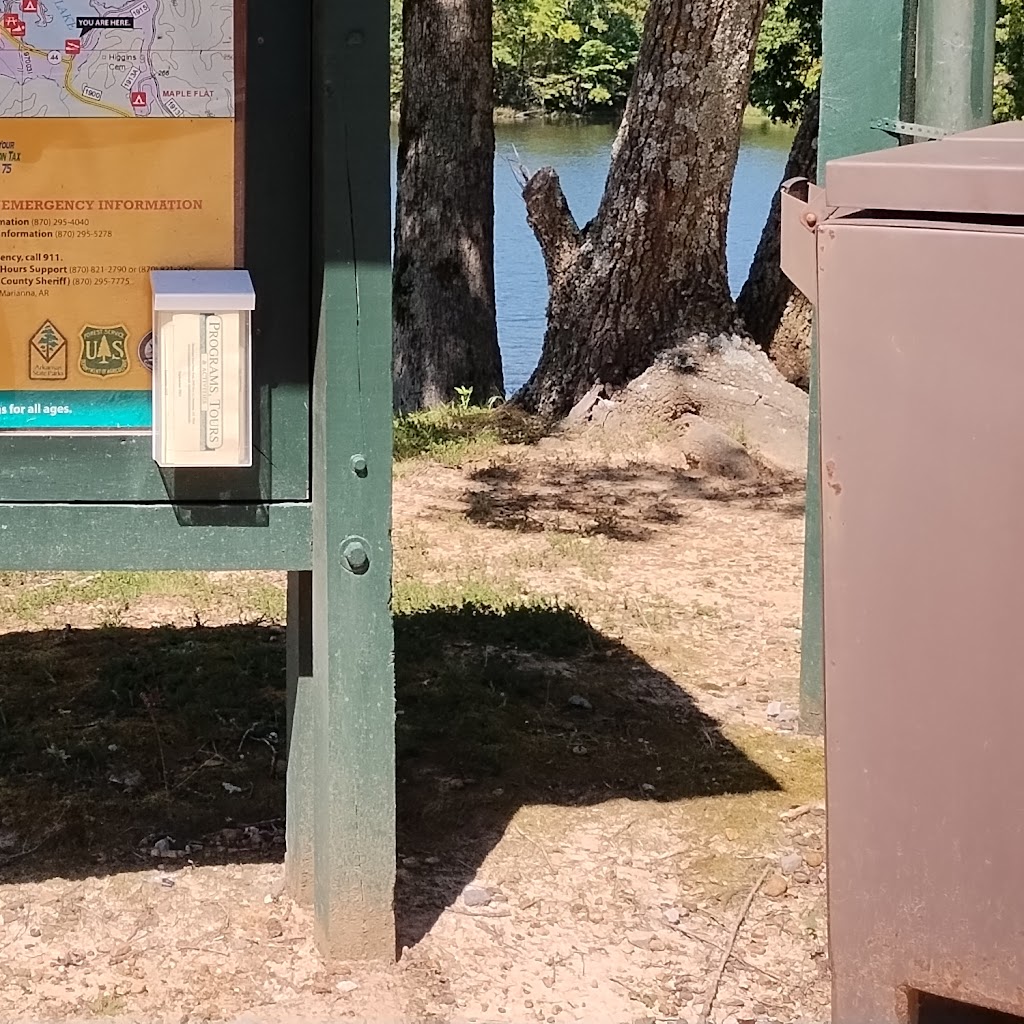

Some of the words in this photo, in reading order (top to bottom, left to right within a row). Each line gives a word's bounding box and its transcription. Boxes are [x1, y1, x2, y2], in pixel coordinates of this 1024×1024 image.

[98, 200, 202, 210] INFORMATION
[25, 253, 41, 261] call
[43, 253, 63, 262] 911.
[1, 278, 34, 286] County
[35, 277, 71, 286] Sheriff)
[72, 278, 92, 286] (870)
[9, 403, 26, 414] for
[27, 403, 41, 413] all
[43, 403, 72, 416] ages.
